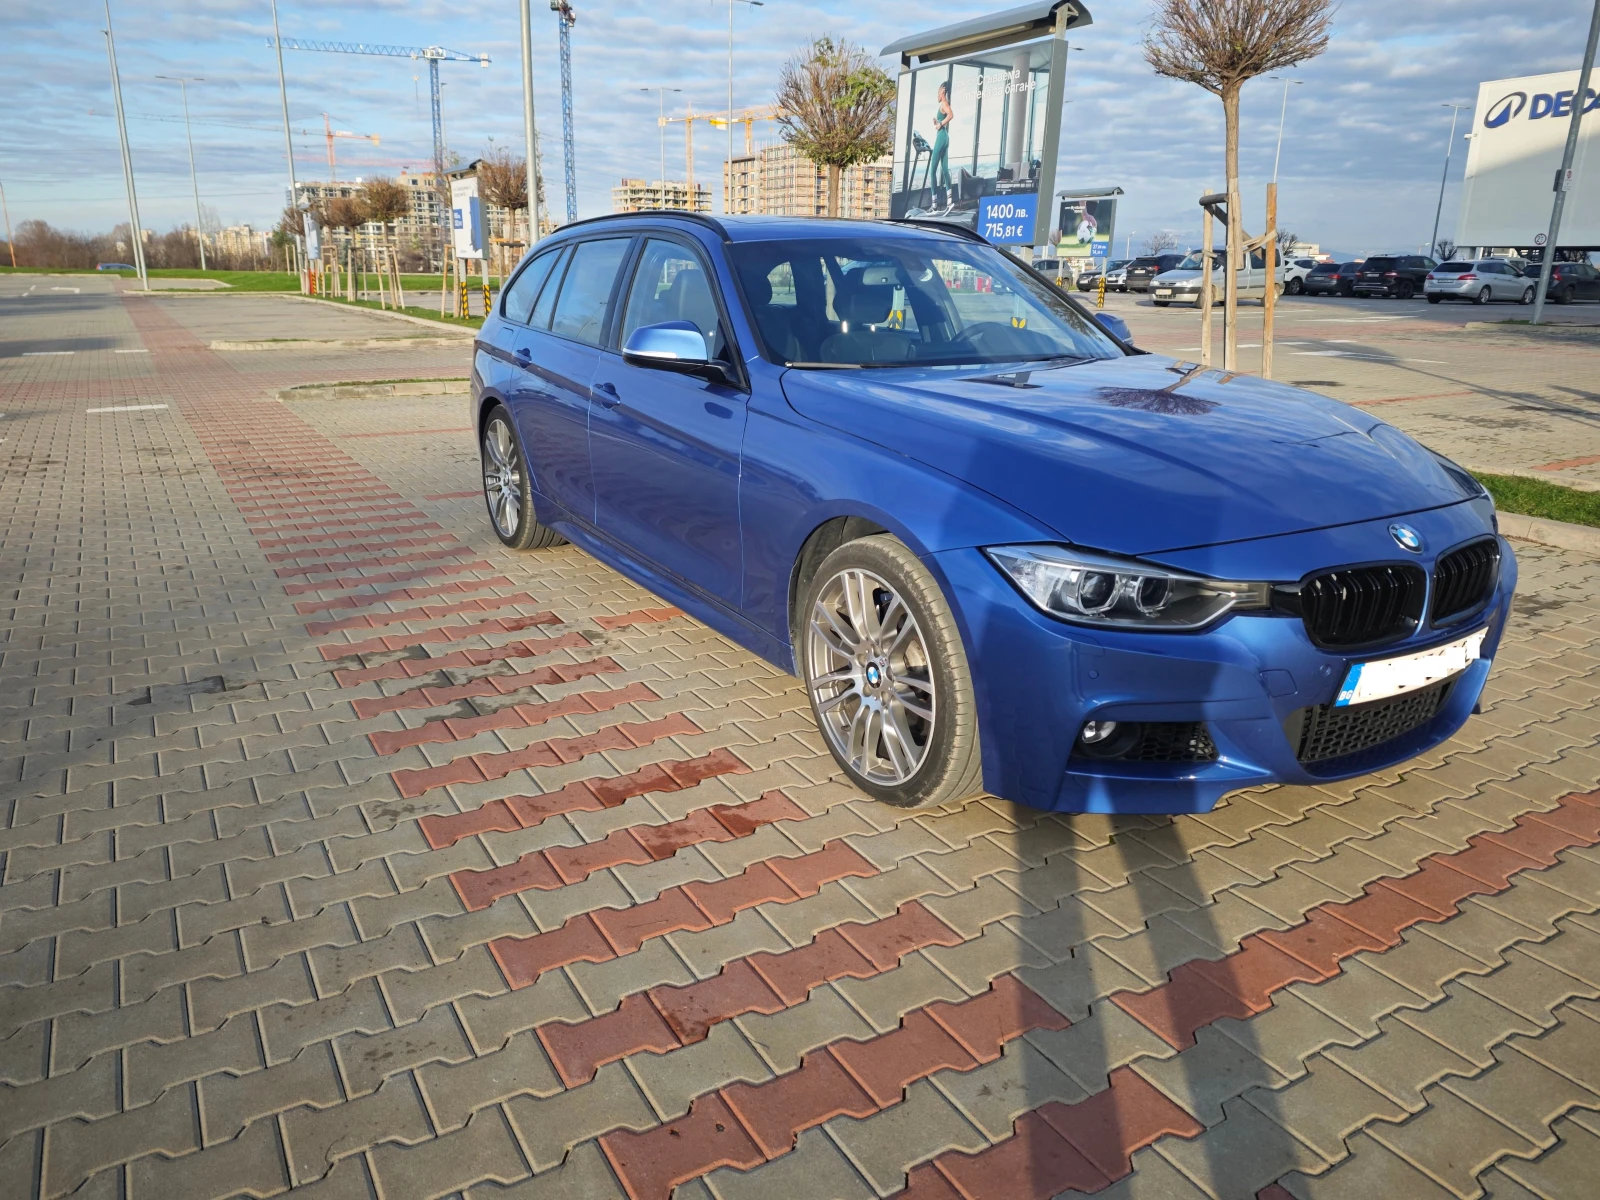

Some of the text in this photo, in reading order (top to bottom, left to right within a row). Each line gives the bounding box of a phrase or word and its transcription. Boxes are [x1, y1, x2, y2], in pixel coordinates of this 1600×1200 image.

[1005, 81, 1036, 95] бягане
[1528, 88, 1600, 120] DEC
[986, 203, 1029, 219] 1400 лв.
[985, 223, 1024, 239] 715,81 €
[1338, 690, 1354, 701] BG
